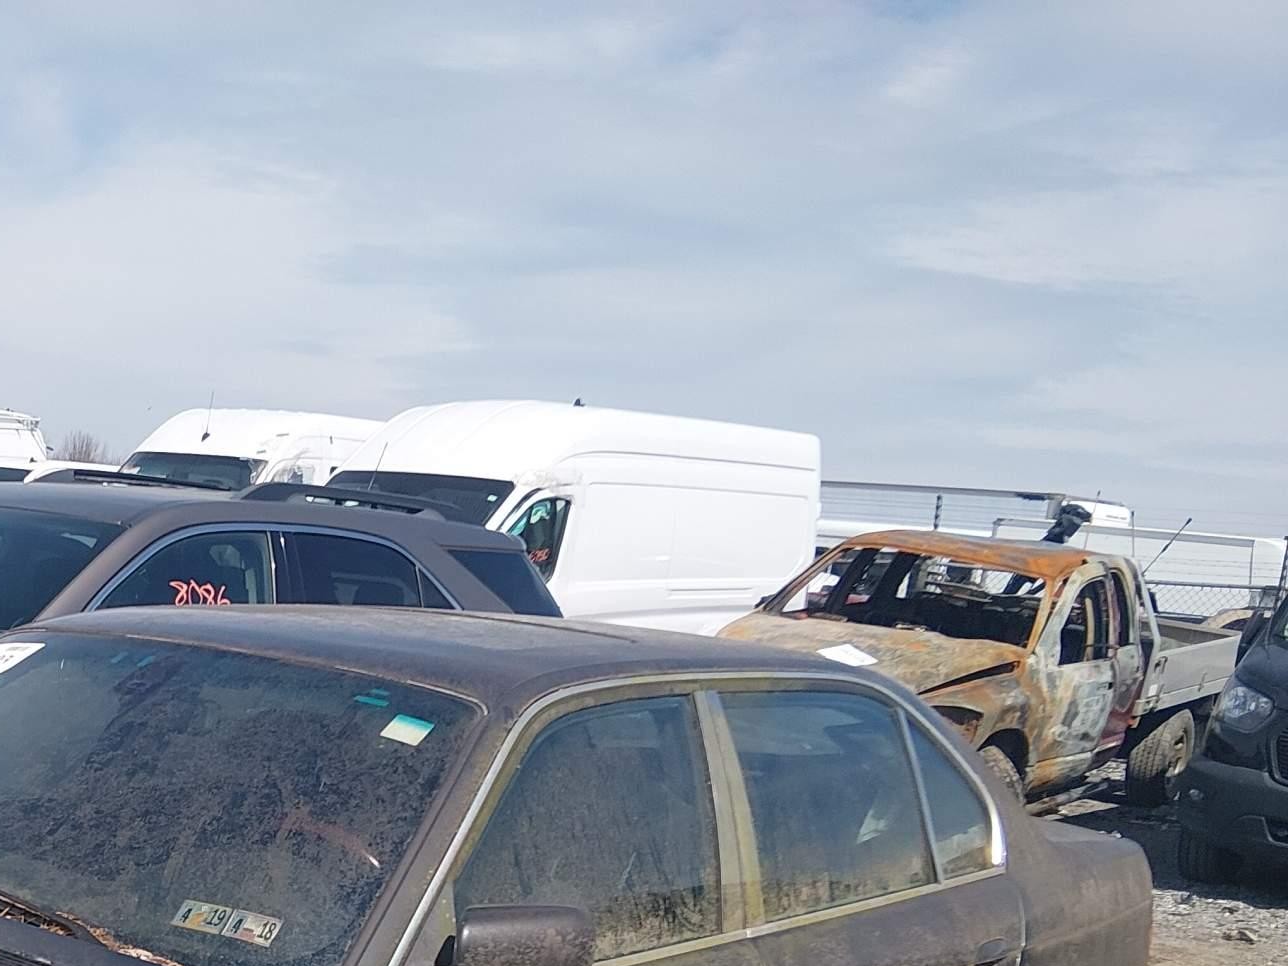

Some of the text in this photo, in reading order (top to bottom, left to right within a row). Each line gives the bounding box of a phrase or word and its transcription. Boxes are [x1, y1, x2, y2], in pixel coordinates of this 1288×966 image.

[169, 579, 231, 606] 8086
[177, 908, 227, 927] 4 19
[231, 918, 277, 941] 4 18
